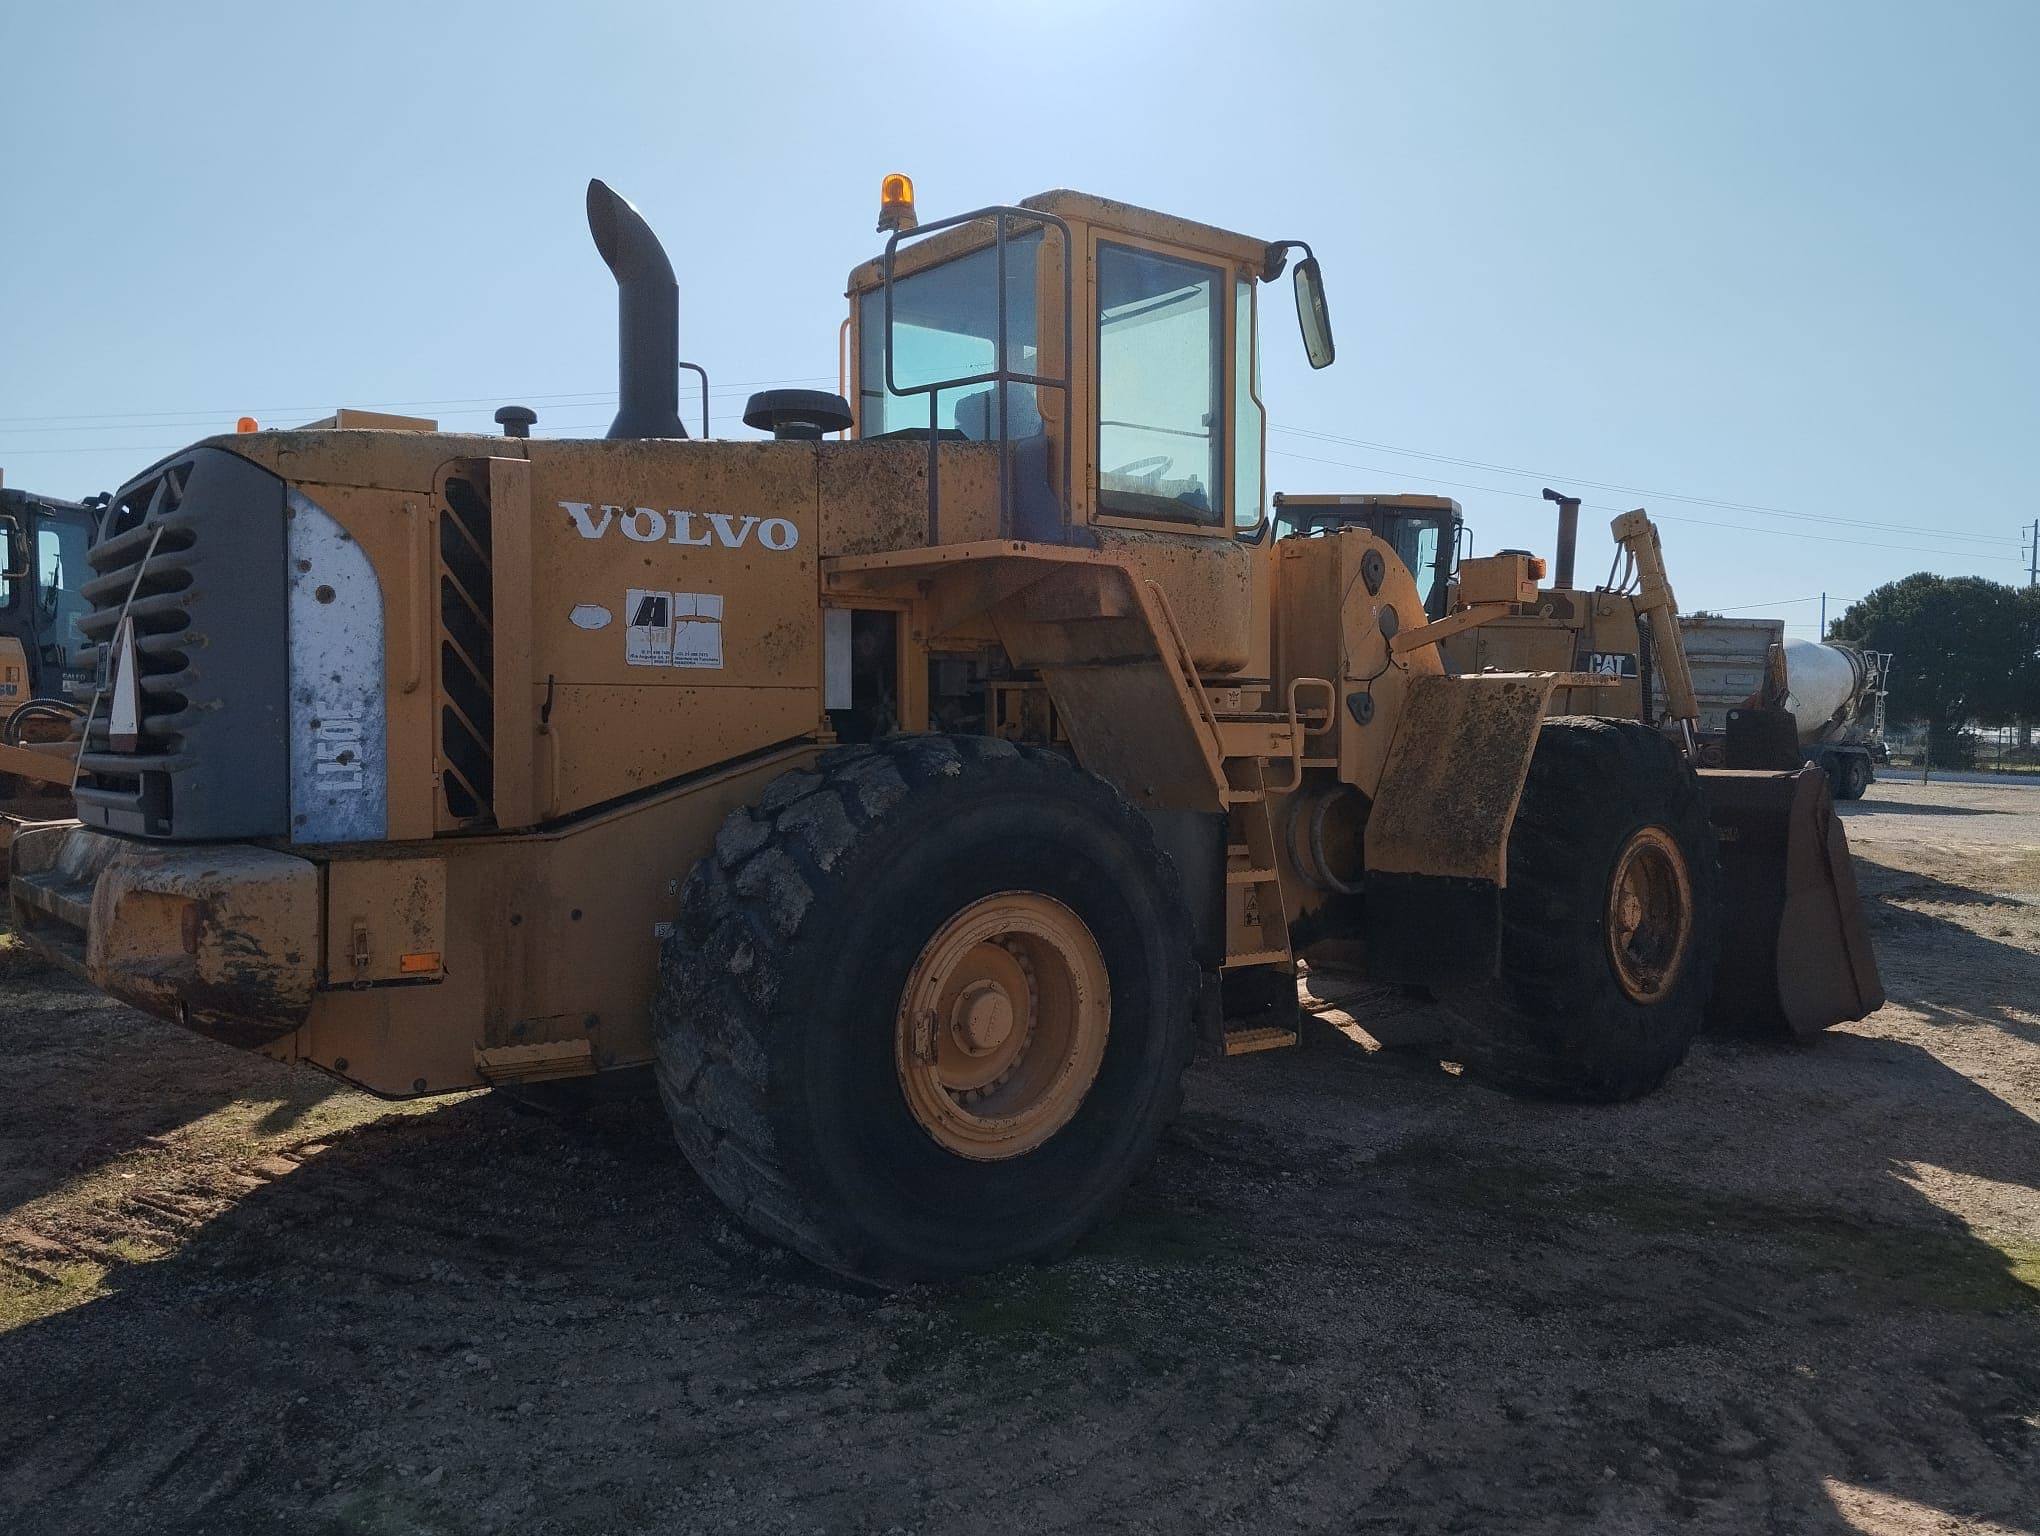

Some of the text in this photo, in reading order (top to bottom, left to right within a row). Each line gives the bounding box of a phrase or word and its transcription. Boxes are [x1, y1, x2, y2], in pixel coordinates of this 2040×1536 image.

[558, 501, 799, 550] VOLVO
[1589, 653, 1626, 676] CAT
[316, 701, 363, 790] L150E
